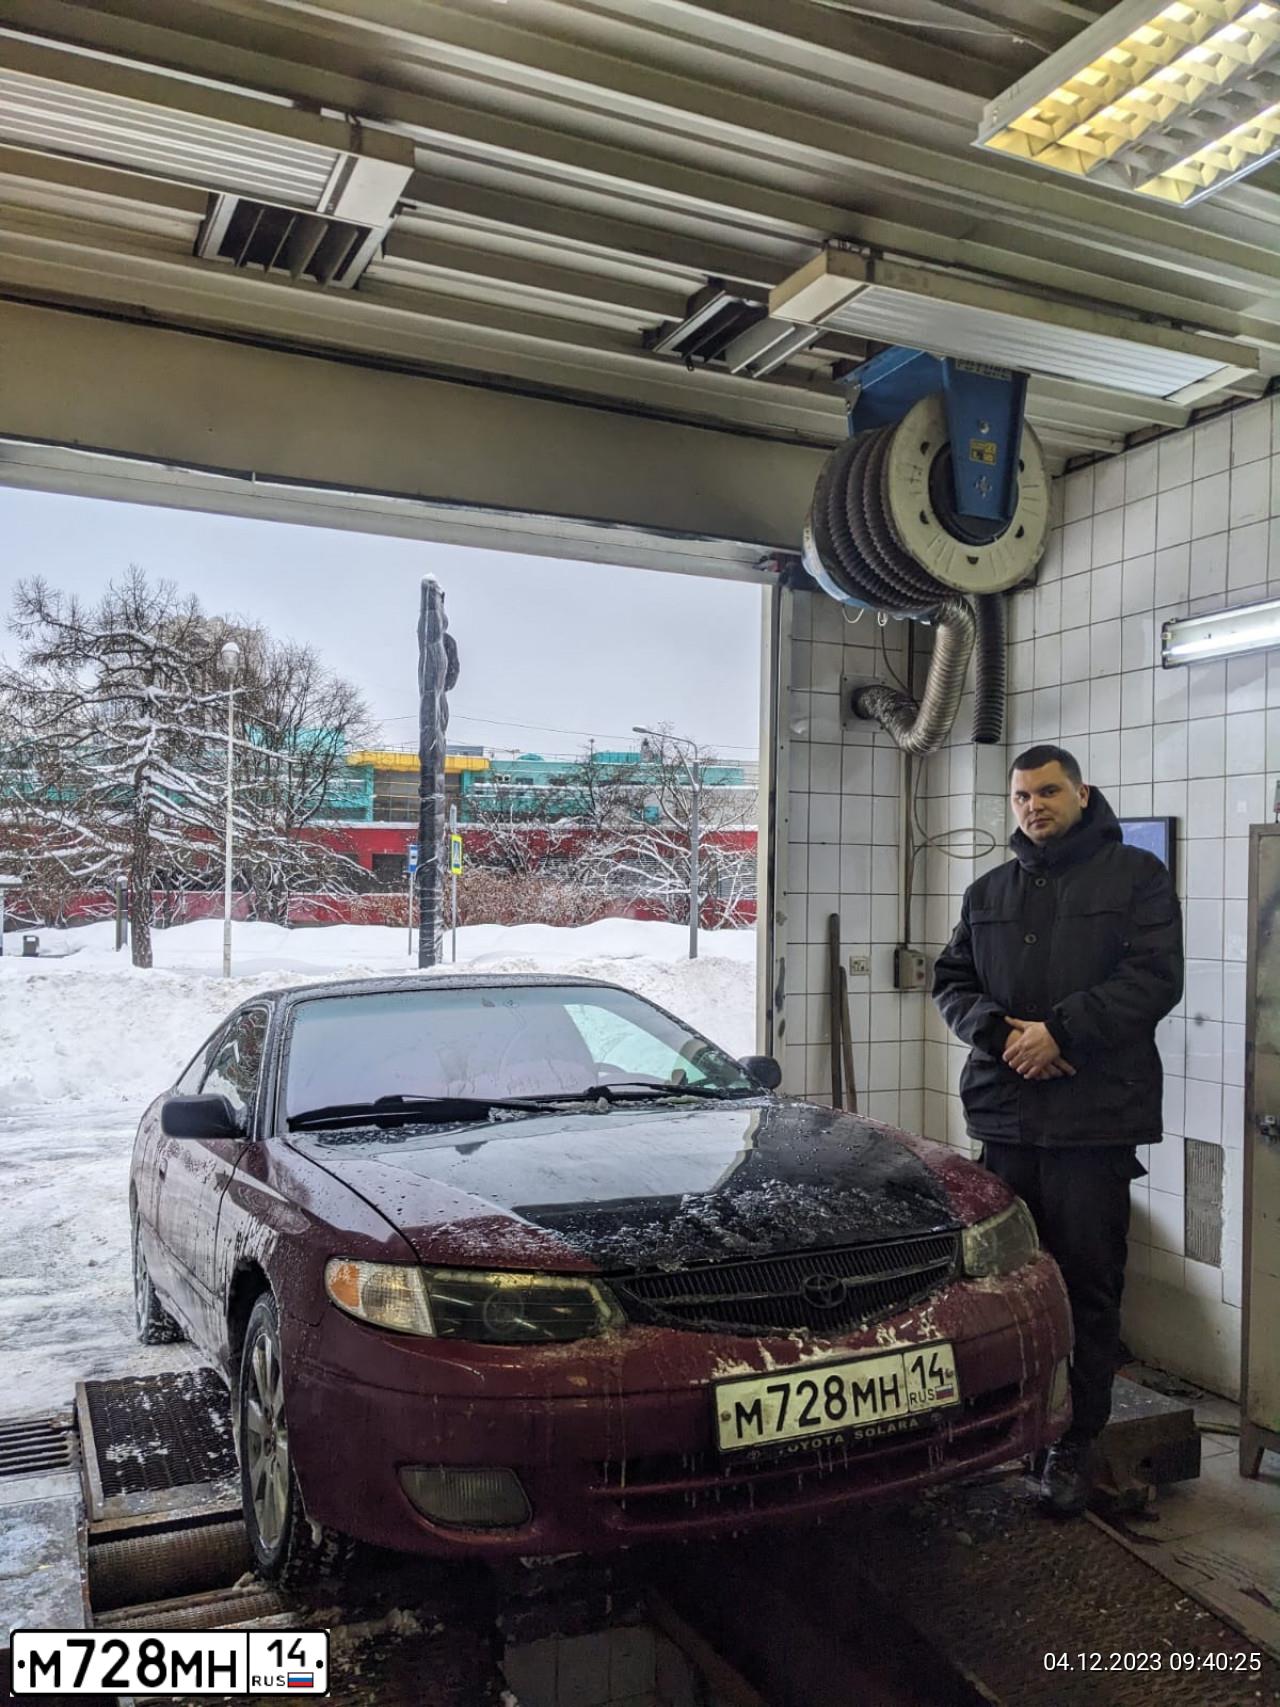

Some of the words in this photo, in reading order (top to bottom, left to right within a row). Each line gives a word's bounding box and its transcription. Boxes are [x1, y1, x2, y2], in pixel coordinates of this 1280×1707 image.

[911, 1352, 944, 1389] 14
[734, 1373, 900, 1439] М728МН
[909, 1388, 935, 1405] RUS
[854, 1418, 919, 1440] SOLARA
